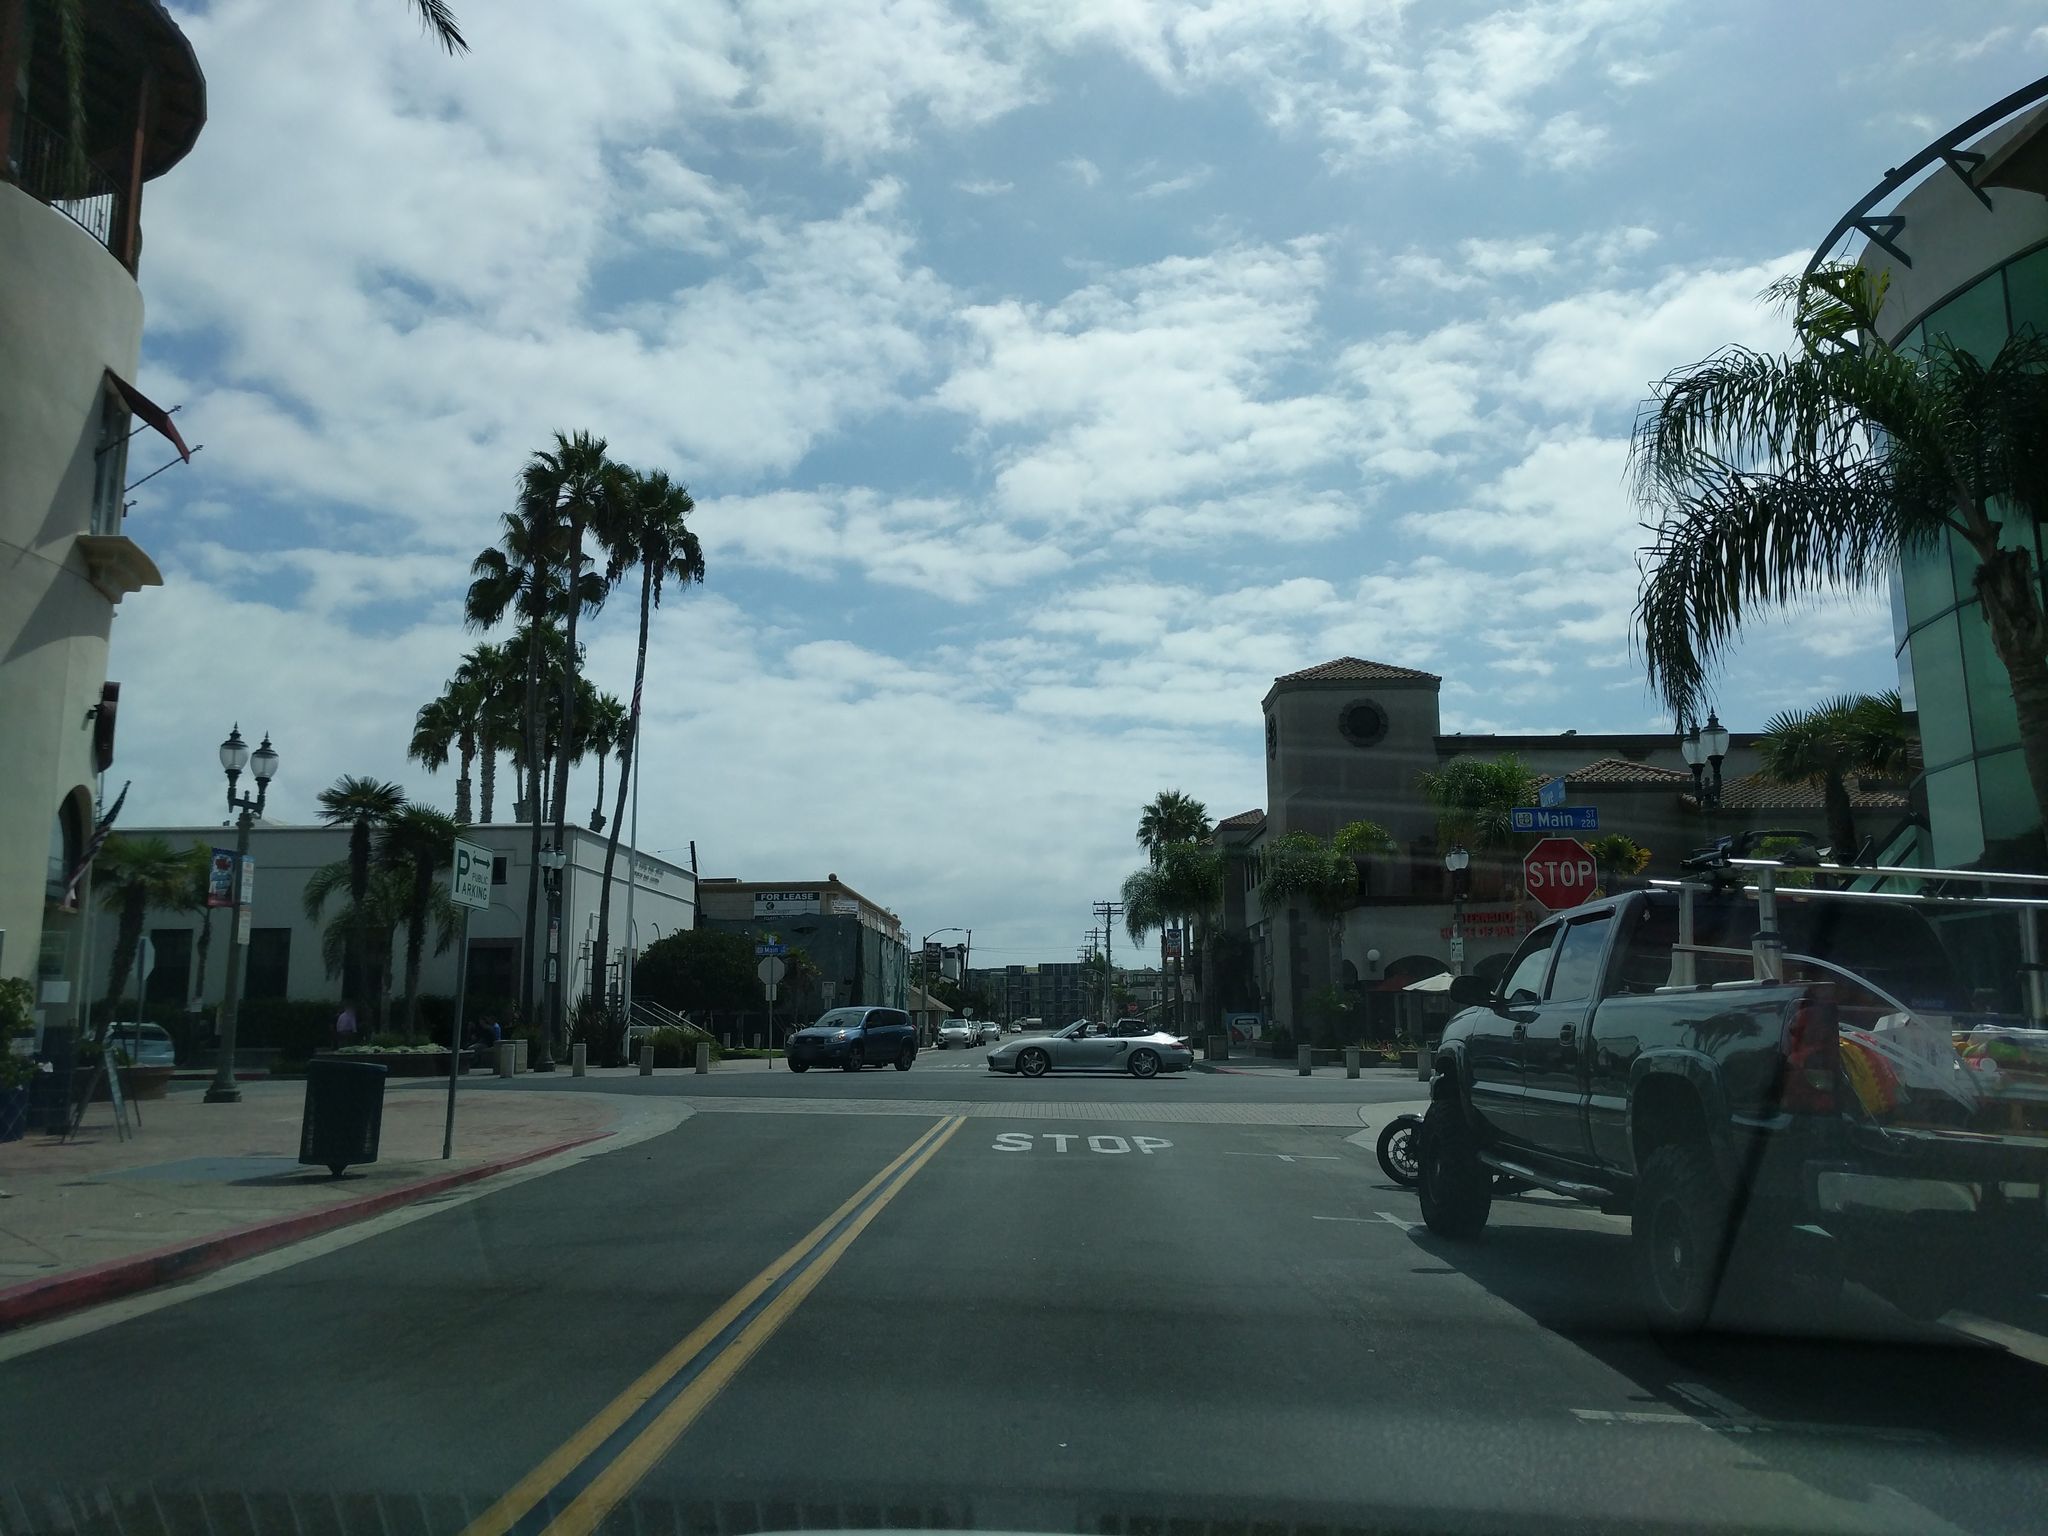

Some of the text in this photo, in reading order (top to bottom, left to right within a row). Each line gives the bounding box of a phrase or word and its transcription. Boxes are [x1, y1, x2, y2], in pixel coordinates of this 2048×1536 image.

[1538, 809, 1595, 828] Main ST
[1581, 819, 1596, 828] 220
[472, 872, 488, 885] PUBLIC
[1529, 860, 1593, 888] STOP
[760, 892, 814, 901] FOR LEASE
[991, 1132, 1175, 1155] STOP
